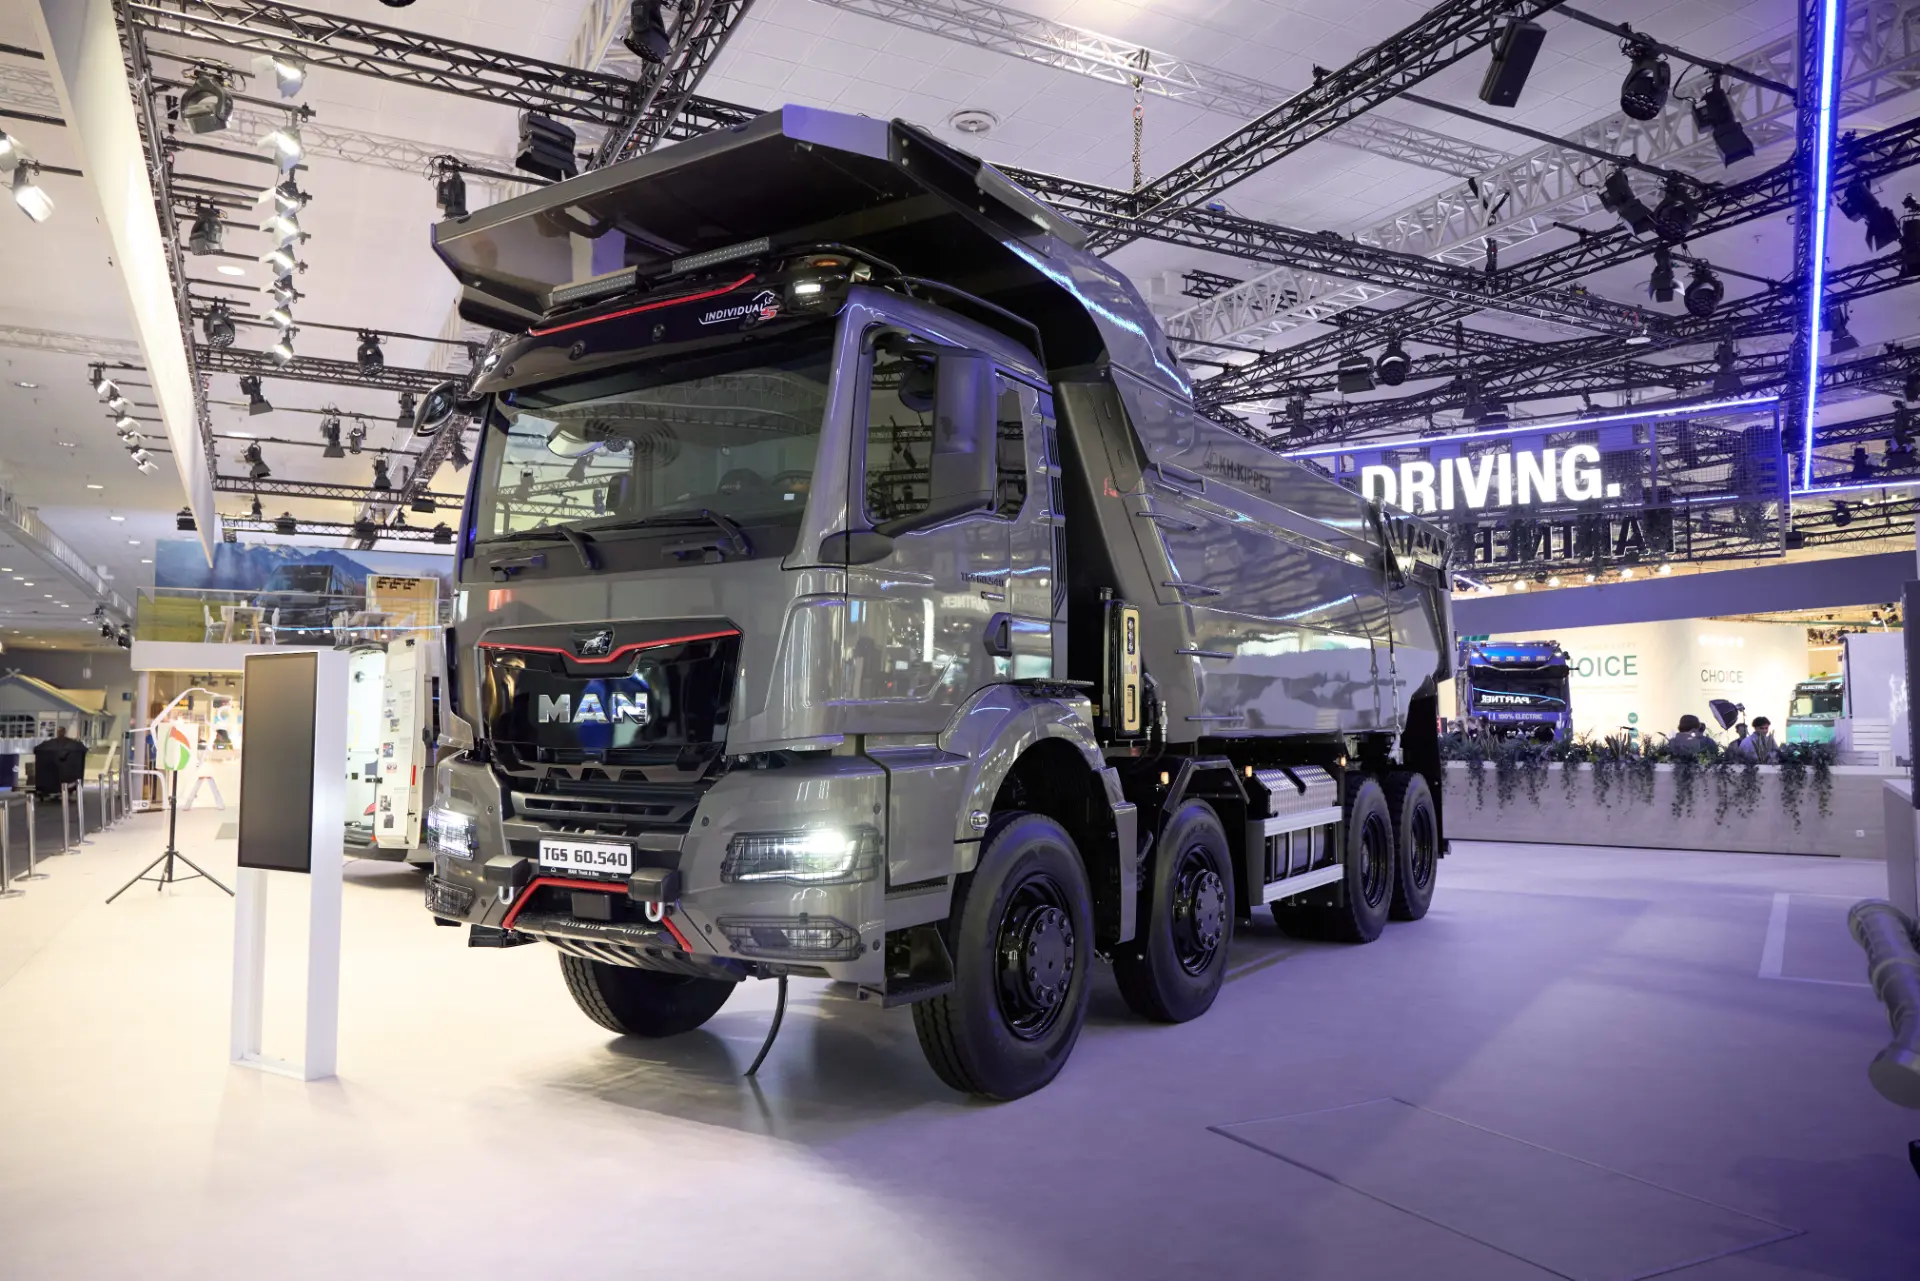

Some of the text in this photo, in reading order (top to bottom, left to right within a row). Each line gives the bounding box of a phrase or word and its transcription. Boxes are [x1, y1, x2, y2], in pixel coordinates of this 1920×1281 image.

[704, 303, 764, 322] INDIVIDUAL
[1361, 444, 1621, 513] DRIVING.
[1700, 668, 1744, 684] CHOICE
[538, 692, 650, 725] MAN
[543, 847, 628, 867] TGS 60.540
